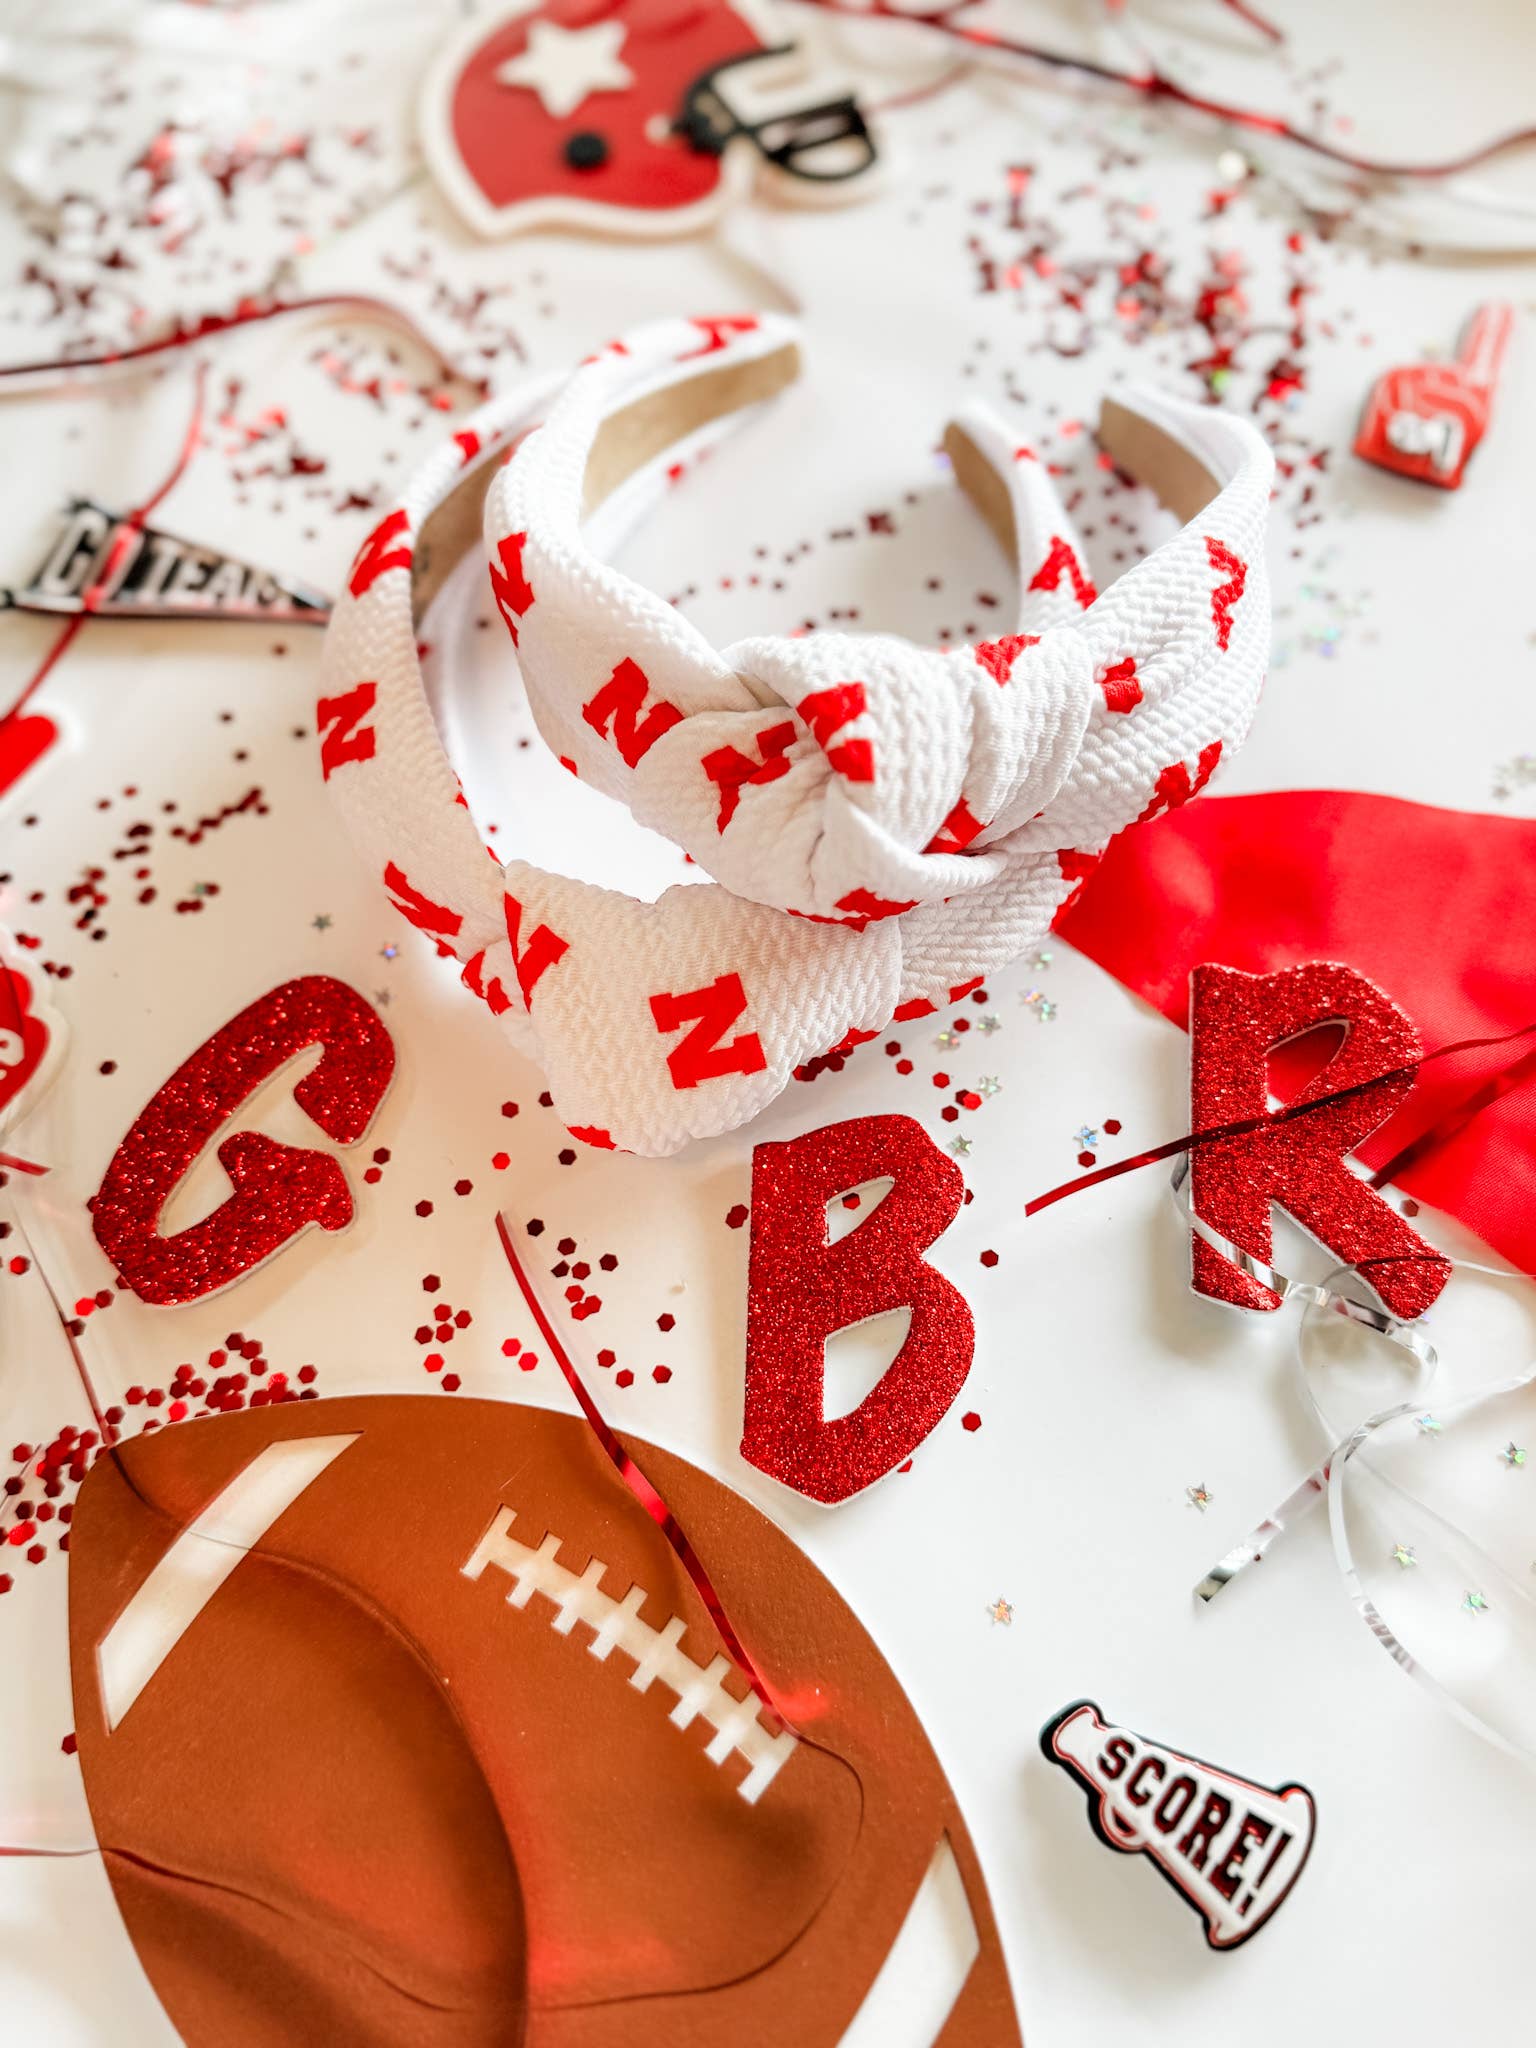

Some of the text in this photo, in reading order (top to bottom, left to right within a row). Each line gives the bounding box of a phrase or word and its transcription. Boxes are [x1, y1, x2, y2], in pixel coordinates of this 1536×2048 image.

[36, 507, 147, 606] GO
[316, 681, 377, 783] N
[648, 971, 767, 1091] N
[92, 961, 1452, 1508] G B R
[1096, 1735, 1294, 1918] SCORE!
